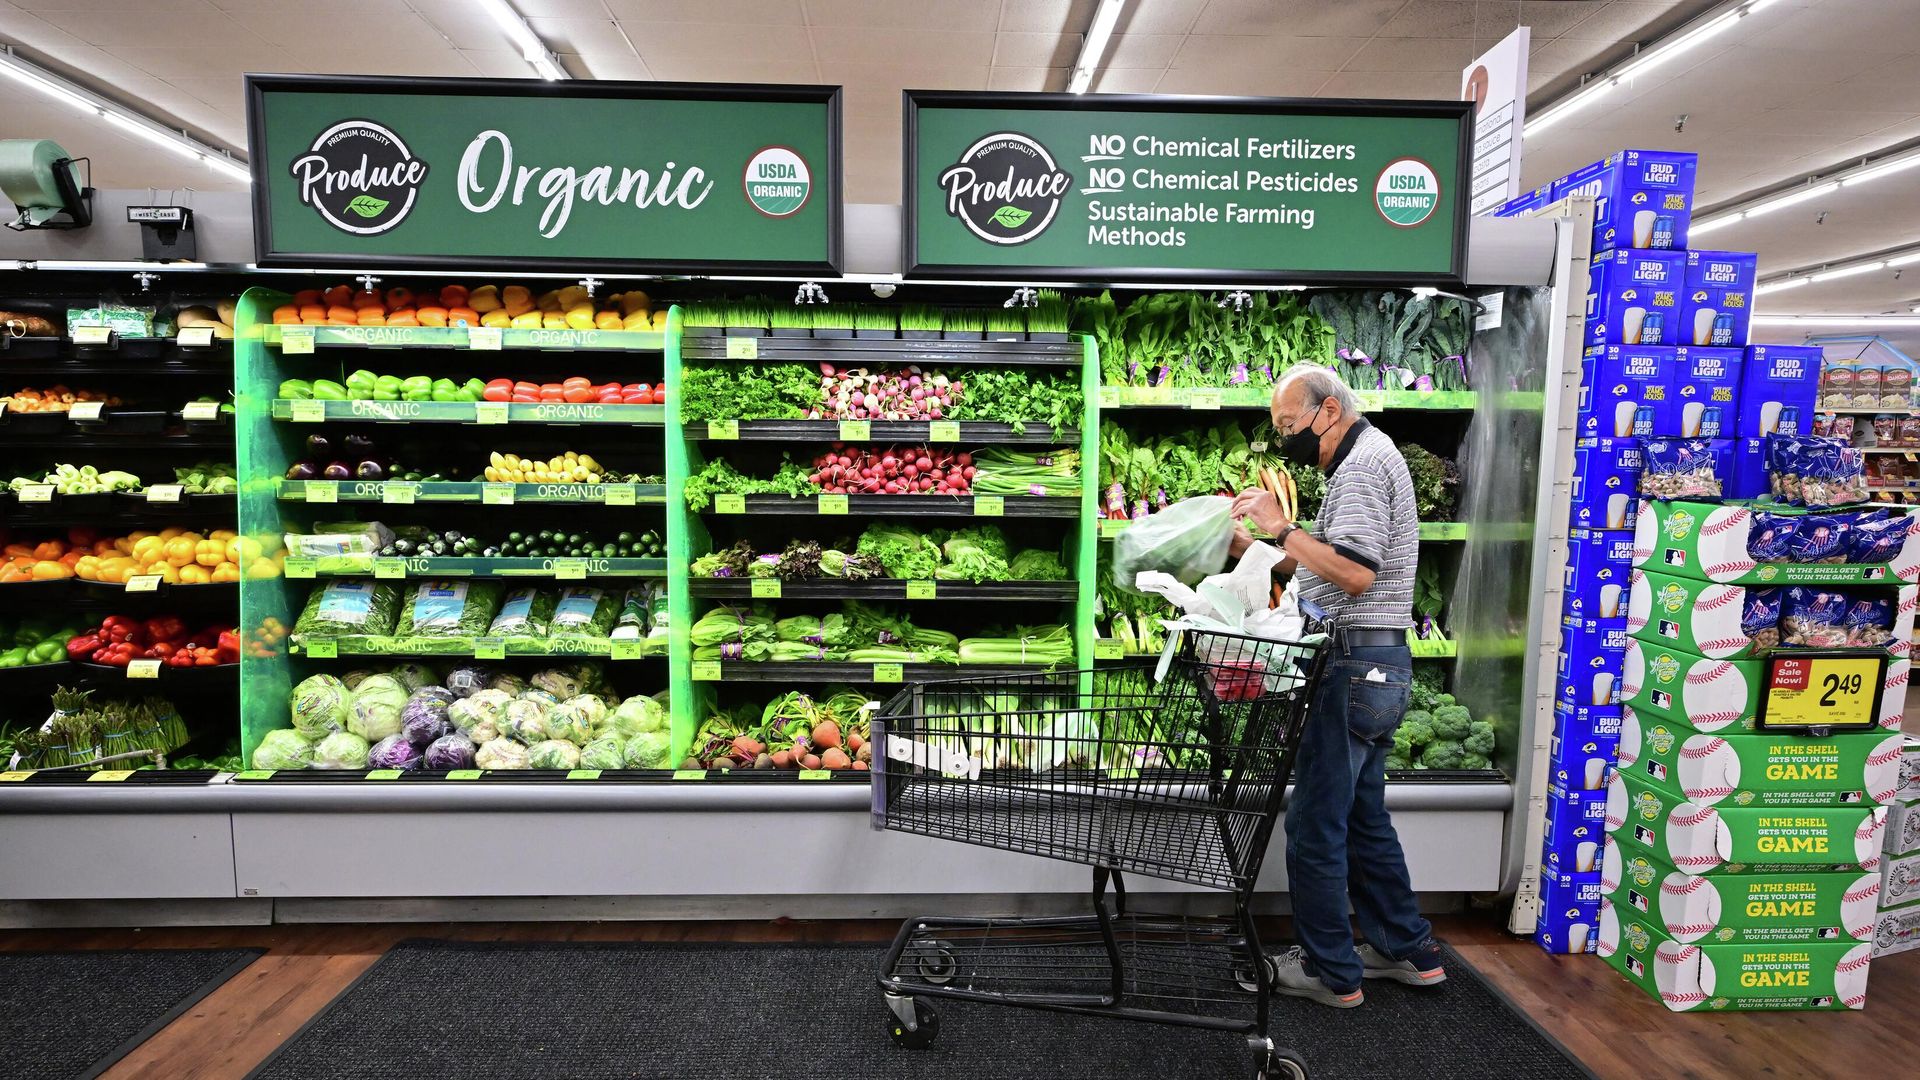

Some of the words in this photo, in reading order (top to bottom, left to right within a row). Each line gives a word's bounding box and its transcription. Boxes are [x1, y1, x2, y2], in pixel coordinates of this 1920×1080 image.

[326, 130, 359, 148] PREMIUM
[359, 130, 391, 148] QUALITY
[976, 142, 1007, 160] PREMIUM
[1007, 141, 1039, 159] QUALITY
[1089, 135, 1126, 158] NO
[1132, 135, 1242, 159] Chemical
[1248, 138, 1356, 162] Fertilizers
[758, 162, 797, 181] USDA
[1650, 163, 1673, 173] BUD
[292, 154, 427, 202] Produce
[1089, 168, 1126, 191] NO
[1132, 168, 1242, 192] Chemical
[1249, 169, 1359, 195] Pesticides
[1389, 174, 1426, 191] USDA
[1644, 172, 1677, 183] LIGHT
[456, 130, 714, 239] Organic
[942, 165, 1073, 215] Produce
[753, 184, 803, 198] ORGANIC
[1382, 194, 1430, 211] ORGANIC
[1088, 200, 1220, 224] Sustainable
[1225, 203, 1315, 230] Farming
[1088, 225, 1187, 249] Methods
[1640, 262, 1663, 271] BUD
[1710, 263, 1733, 273] BUD
[1634, 271, 1666, 281] LIGHT
[1705, 271, 1737, 282] LIGHT
[344, 328, 413, 342] ORGANIC
[529, 330, 599, 344] ORGANIC
[1676, 347, 1688, 355] 30
[1630, 357, 1653, 366] BUD
[1698, 358, 1721, 368] BUD
[1775, 359, 1800, 369] BUD
[1625, 365, 1657, 376] LIGHT
[1693, 366, 1725, 377] LIGHT
[1769, 368, 1804, 378] LIGHT
[351, 403, 420, 416] ORGANIC
[536, 405, 603, 418] ORGANIC
[1618, 458, 1642, 468] LIGH
[355, 483, 423, 496] ORGC
[537, 485, 605, 499] ORGANIC
[1609, 550, 1633, 559] LIGH
[543, 559, 610, 573] ONIC
[1602, 638, 1626, 647] LIGH
[1778, 668, 1802, 676] Sale
[1599, 718, 1621, 726] BUD
[1769, 745, 1782, 755] IN
[1783, 745, 1804, 755] THE
[1806, 745, 1839, 755] SHELL
[1766, 764, 1839, 780] GAME
[1590, 802, 1605, 811] BU
[1759, 817, 1770, 827] IN
[1772, 817, 1793, 827] THE
[1795, 817, 1827, 827] SHELL
[1757, 837, 1829, 853] GAME
[1749, 883, 1761, 893] IN
[1763, 883, 1784, 893] THE
[1785, 883, 1817, 893] SHELL
[1577, 892, 1600, 900] LIGH
[1747, 893, 1769, 901] GETS
[1770, 893, 1787, 901] YOU
[1788, 893, 1798, 901] IN
[1799, 893, 1817, 901] THE
[1745, 901, 1816, 917] GAME
[1743, 953, 1755, 962] IN
[1756, 953, 1777, 962] THE
[1778, 953, 1810, 962] SHELL
[1740, 971, 1810, 987] GAME
